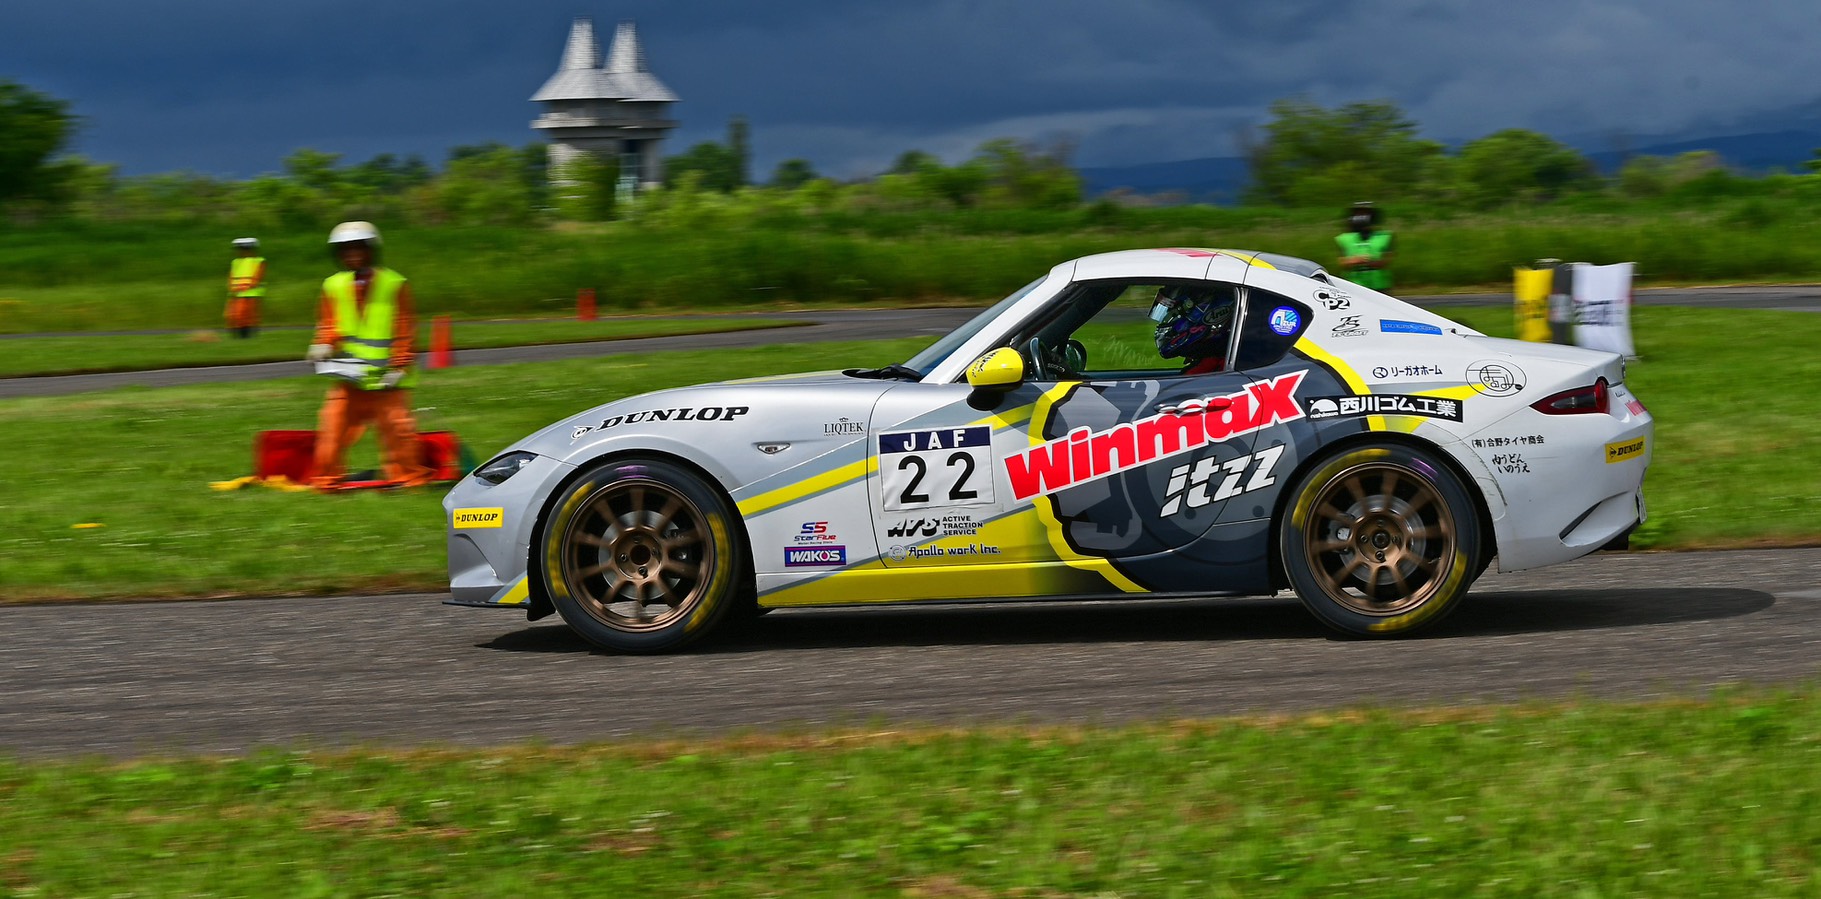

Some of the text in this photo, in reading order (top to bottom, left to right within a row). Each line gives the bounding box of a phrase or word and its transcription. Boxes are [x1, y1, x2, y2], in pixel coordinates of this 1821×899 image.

[1391, 365, 1443, 377] リーガオホーム
[1339, 396, 1457, 418] 西川ゴム工業
[596, 406, 749, 432] DUNLOP
[824, 422, 864, 435] LIQTEK
[1616, 441, 1644, 456] DUNLOP
[898, 451, 978, 504] 22
[460, 513, 499, 522] DUNLOP
[908, 544, 945, 559] Apollo
[980, 543, 1001, 554] Inc.
